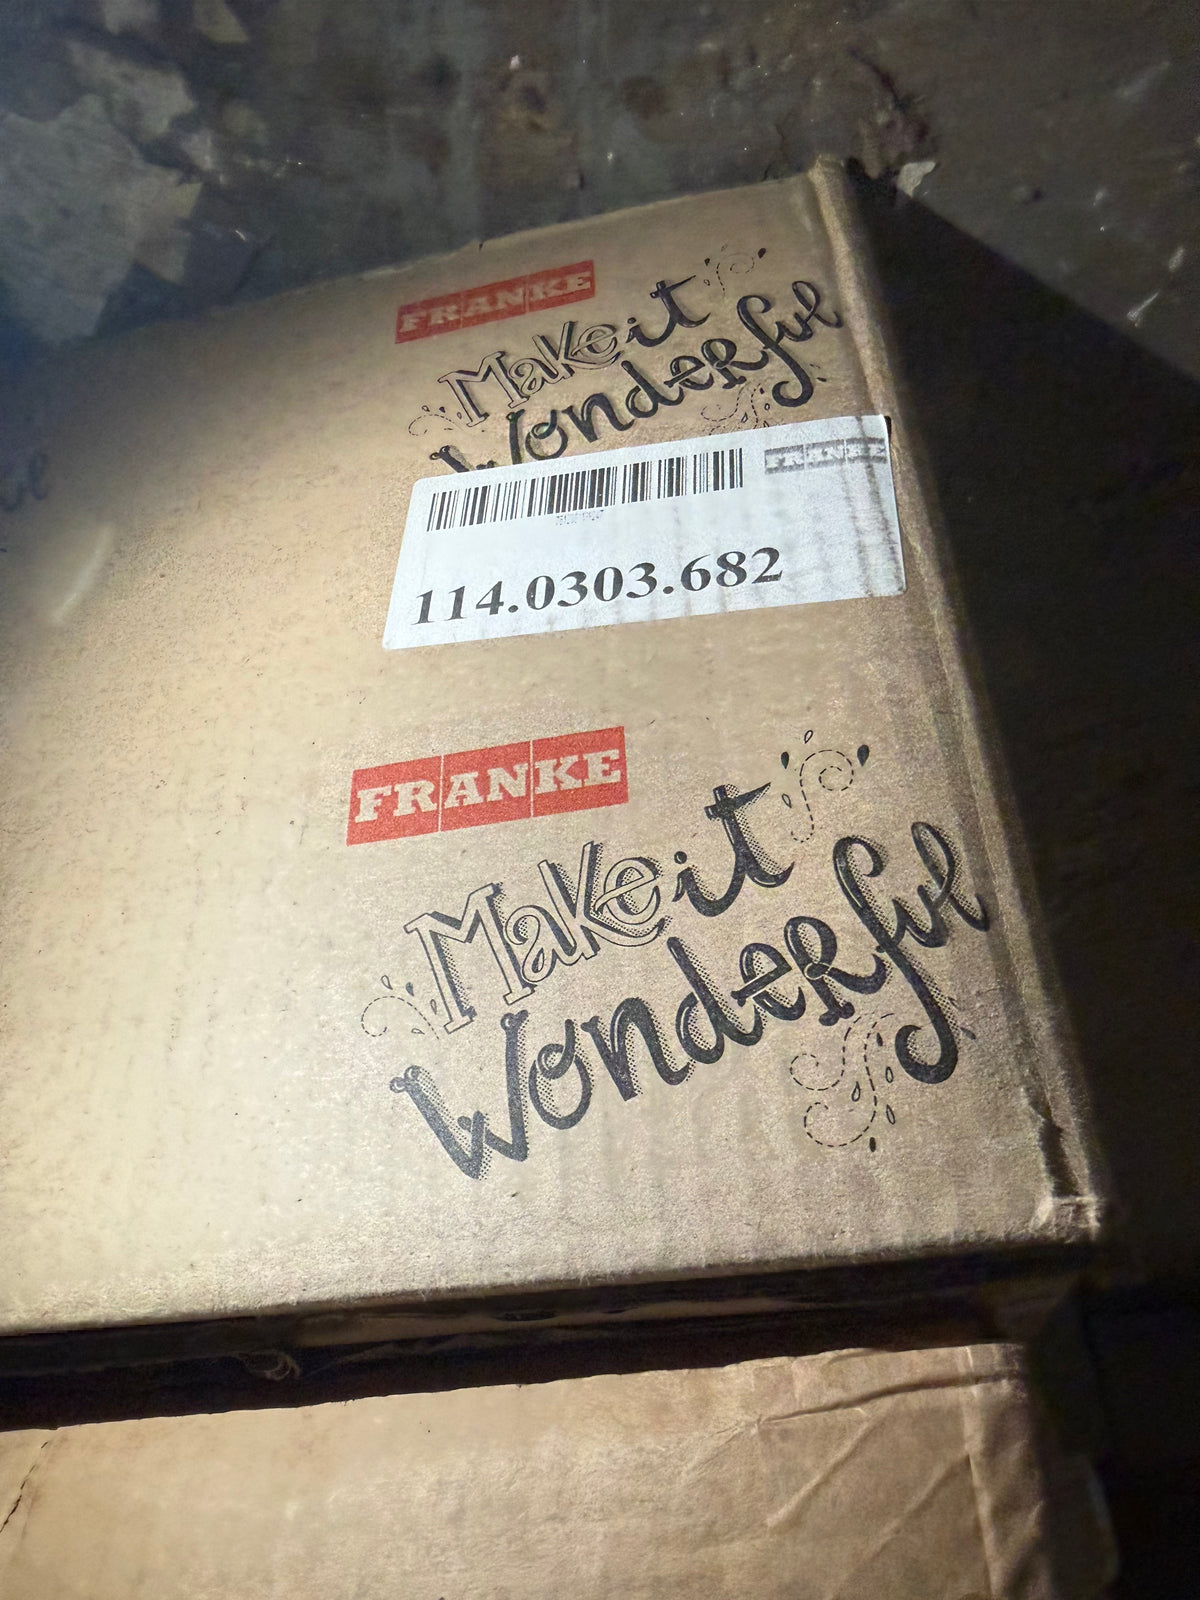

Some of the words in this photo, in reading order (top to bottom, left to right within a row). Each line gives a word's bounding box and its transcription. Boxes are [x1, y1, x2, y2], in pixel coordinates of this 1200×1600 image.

[399, 270, 592, 333] FRANKE
[437, 320, 623, 428] Make
[625, 274, 711, 348] it
[411, 546, 783, 626] 114.0303.682
[353, 747, 623, 824] FRANKE
[403, 841, 673, 1035] Make
[672, 784, 796, 918] it
